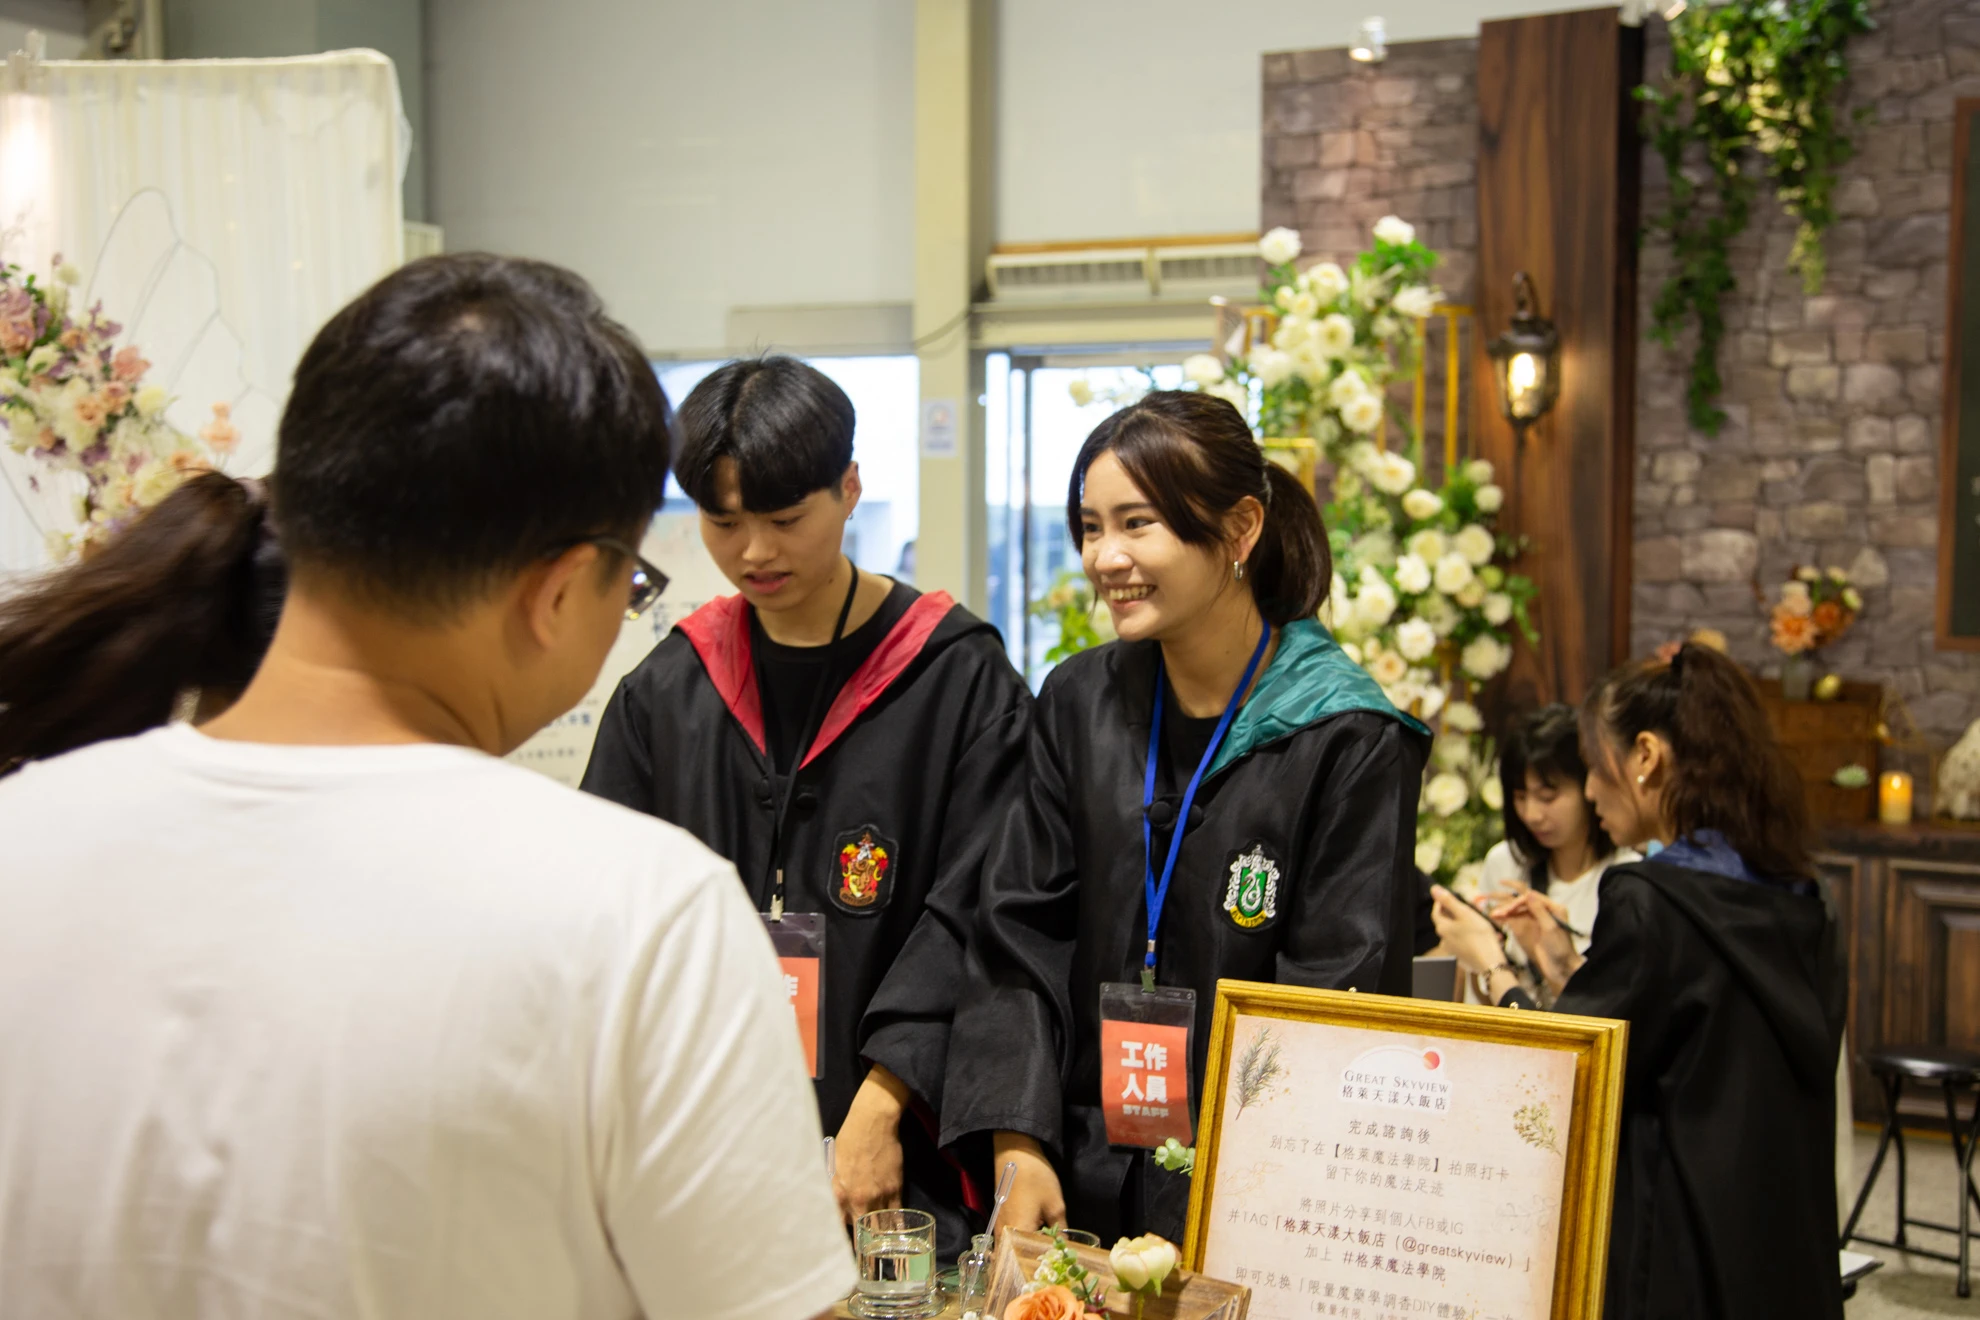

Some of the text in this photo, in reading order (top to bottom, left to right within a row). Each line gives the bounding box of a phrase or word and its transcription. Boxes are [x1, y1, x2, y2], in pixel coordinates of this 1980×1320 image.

[1121, 1040, 1168, 1071] 工作
[1121, 1073, 1168, 1104] 人員
[1342, 1084, 1447, 1111] 格萊天漾大飯店
[1122, 1103, 1170, 1118] STAFF
[1348, 1119, 1431, 1145] 完成諮詢後
